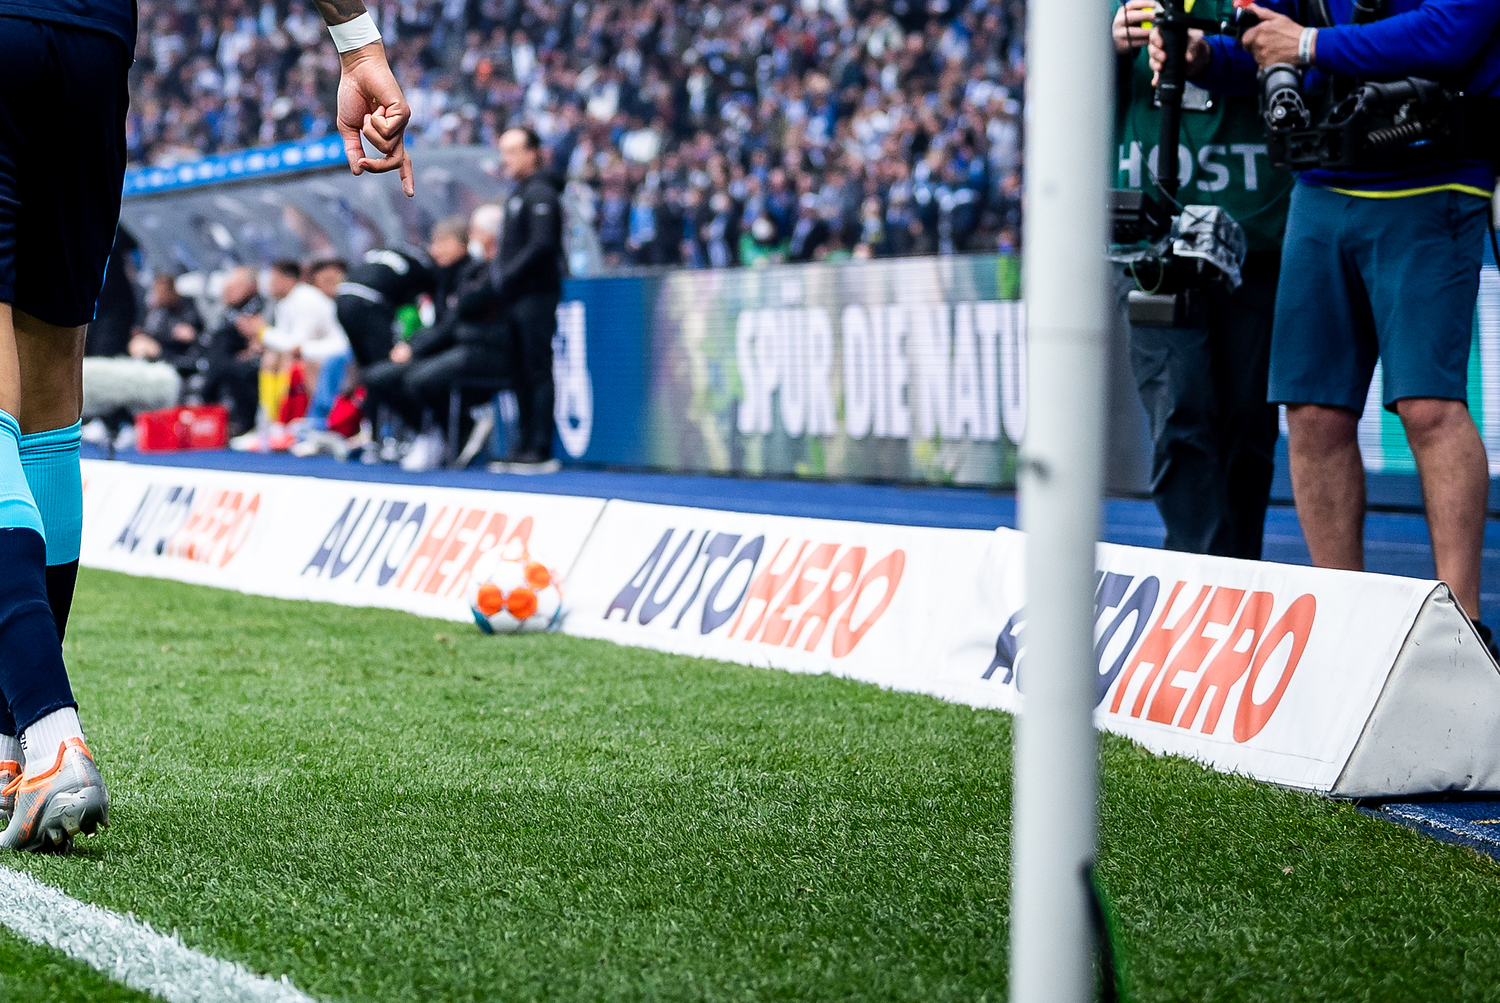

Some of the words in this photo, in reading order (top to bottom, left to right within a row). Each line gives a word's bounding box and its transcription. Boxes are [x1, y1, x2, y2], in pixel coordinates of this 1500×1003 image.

[1118, 140, 1268, 193] HOST
[841, 303, 910, 440] DIE
[603, 527, 906, 658] AUTOHERO
[980, 570, 1317, 744] ATOHERO
